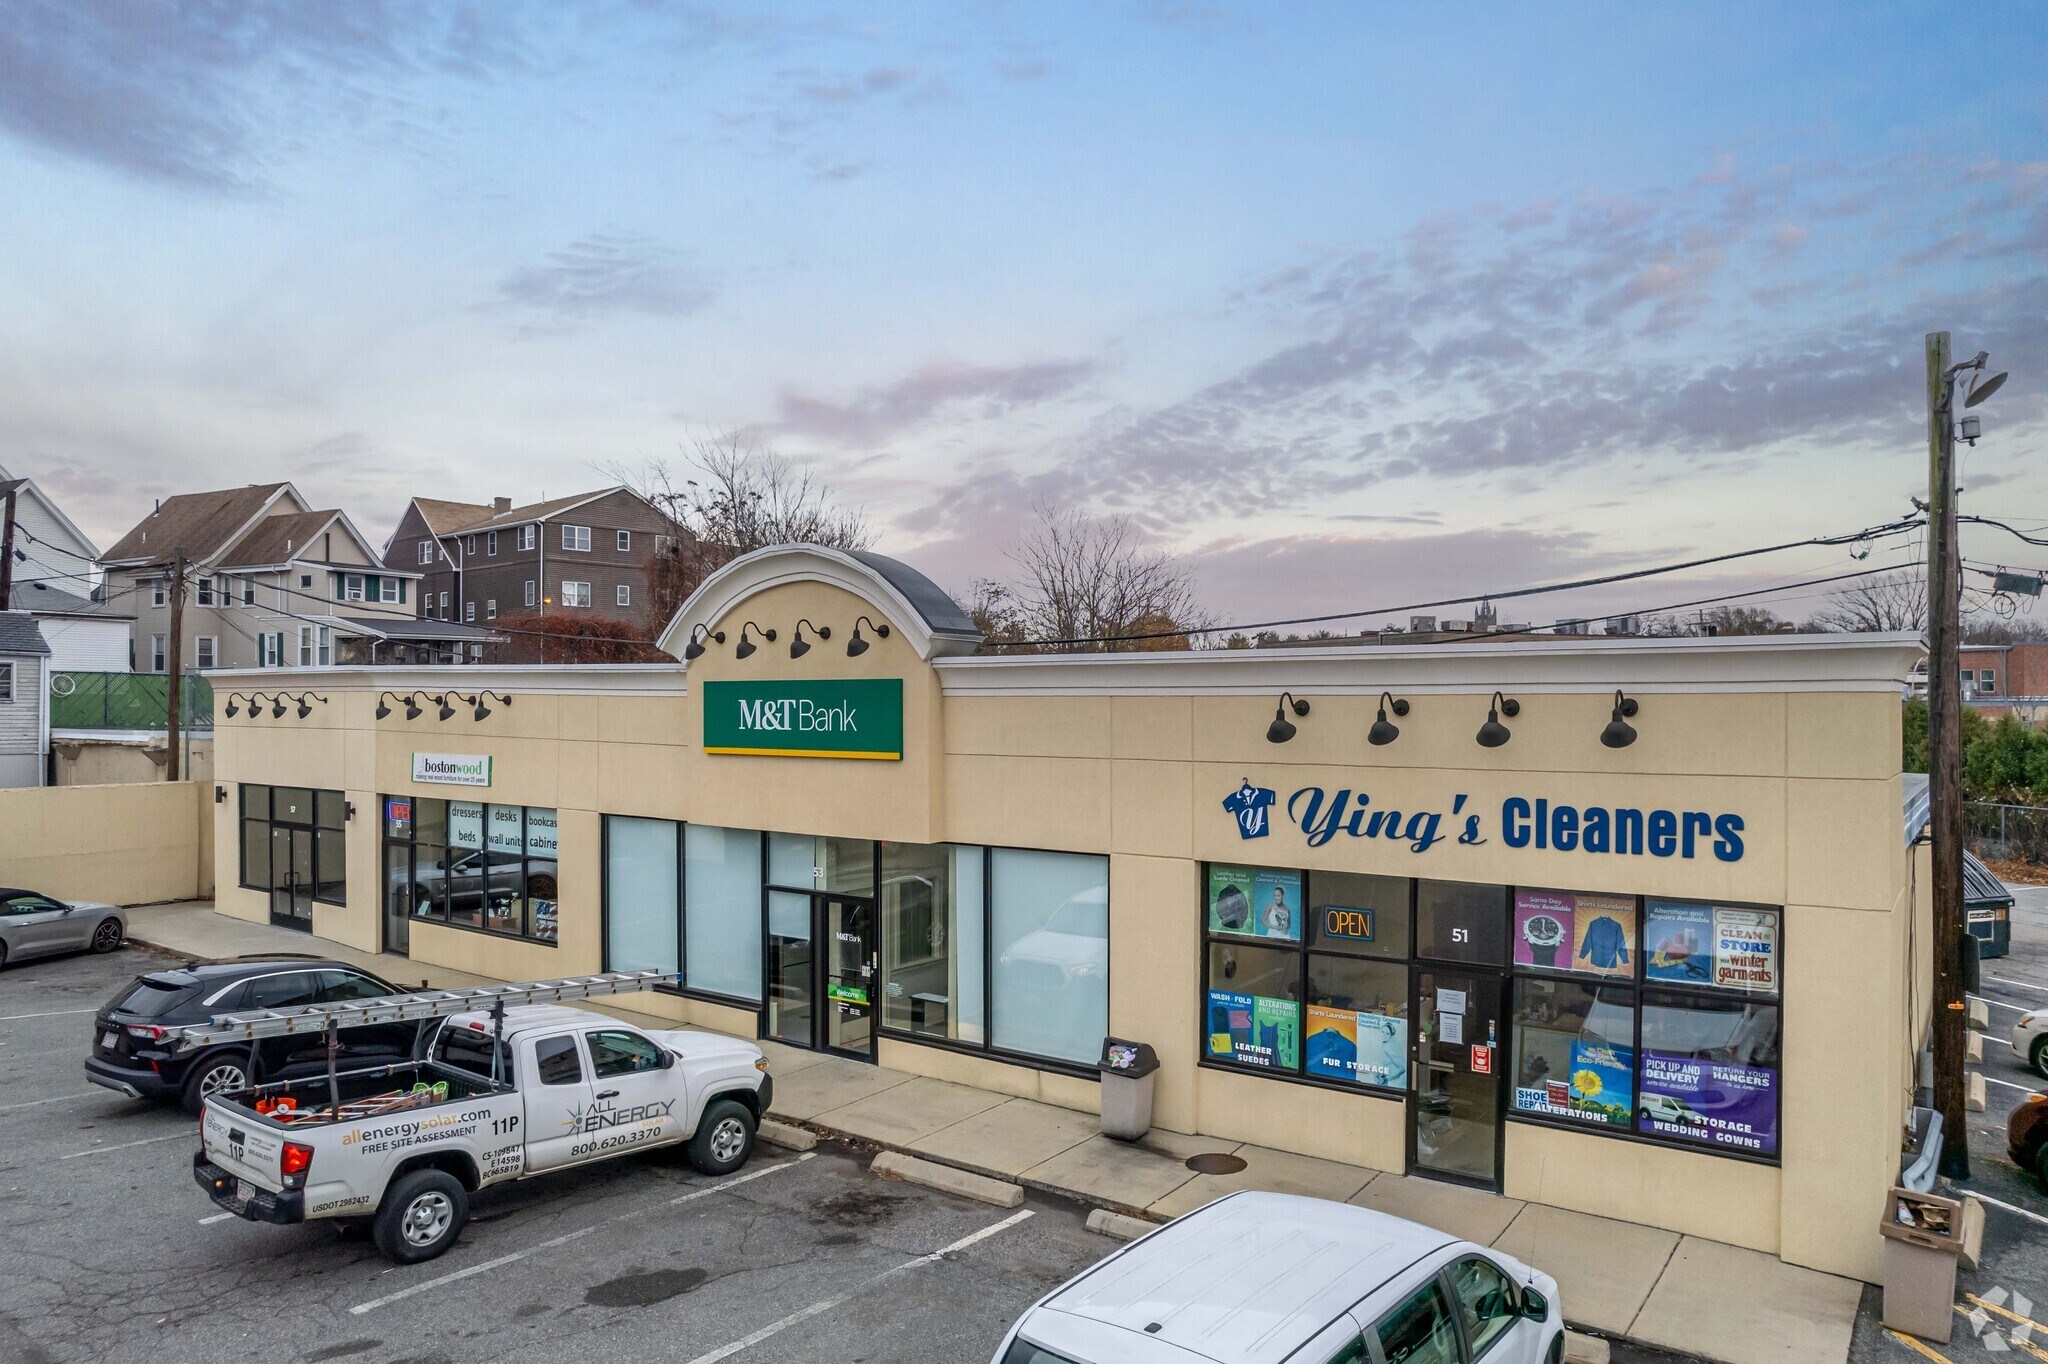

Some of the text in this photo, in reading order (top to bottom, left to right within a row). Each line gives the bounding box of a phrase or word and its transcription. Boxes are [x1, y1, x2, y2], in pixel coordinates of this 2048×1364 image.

[738, 699, 858, 732] M&T Bank
[425, 759, 482, 775] bostonwood
[452, 806, 482, 819] dressers
[495, 809, 517, 822] desks
[1287, 786, 1745, 862] Ying's Cleaners
[459, 830, 476, 842] beds
[489, 834, 504, 844] wall
[814, 868, 824, 878] 53
[1518, 902, 1572, 912] Service Available
[1597, 902, 1633, 911] Laundered
[1654, 907, 1688, 916] Alteration
[1327, 910, 1370, 937] OPEN
[1650, 913, 1675, 921] Repairs
[1677, 915, 1710, 924] Available
[1452, 928, 1468, 943] 51
[1720, 929, 1762, 940] CLEAN
[1720, 939, 1772, 953] STORE
[1730, 953, 1768, 968] winter
[1719, 967, 1772, 982] garments
[837, 989, 860, 999] Welcome
[1258, 999, 1297, 1012] ALTERATIONS
[1258, 1006, 1297, 1018] AND REPAIRS
[1308, 1009, 1356, 1022] Shirts Laundered
[1358, 1013, 1381, 1023] Wedding
[1235, 1042, 1272, 1056] LEATHER
[1237, 1054, 1270, 1066] SUEDES
[1322, 1058, 1390, 1075] FUR STORAGE
[1646, 1059, 1700, 1076] PICK UP AND
[1713, 1066, 1770, 1079] RETURN YOUR
[1646, 1069, 1700, 1085] DELIVERY
[1713, 1071, 1770, 1087] HANGERS
[1646, 1080, 1699, 1092] service available
[1518, 1090, 1547, 1102] SHOE
[586, 1100, 617, 1116] ALL
[1534, 1103, 1608, 1122] ALTERATIONS
[585, 1098, 676, 1133] ENERGY
[641, 1117, 665, 1128] SOLAR
[342, 1107, 491, 1147] allenergysolar.com
[492, 1116, 519, 1136] 11P
[1694, 1116, 1752, 1133] STORAGE
[361, 1125, 477, 1155] FREE SITE ASSESSMENT
[571, 1127, 662, 1156] 800.620.3370
[1653, 1121, 1761, 1149] WEDDING GOWNS
[229, 1143, 244, 1162] 11P
[482, 1145, 521, 1161] CS-109847
[491, 1155, 521, 1168] E 14598
[482, 1164, 519, 1180] BC665819
